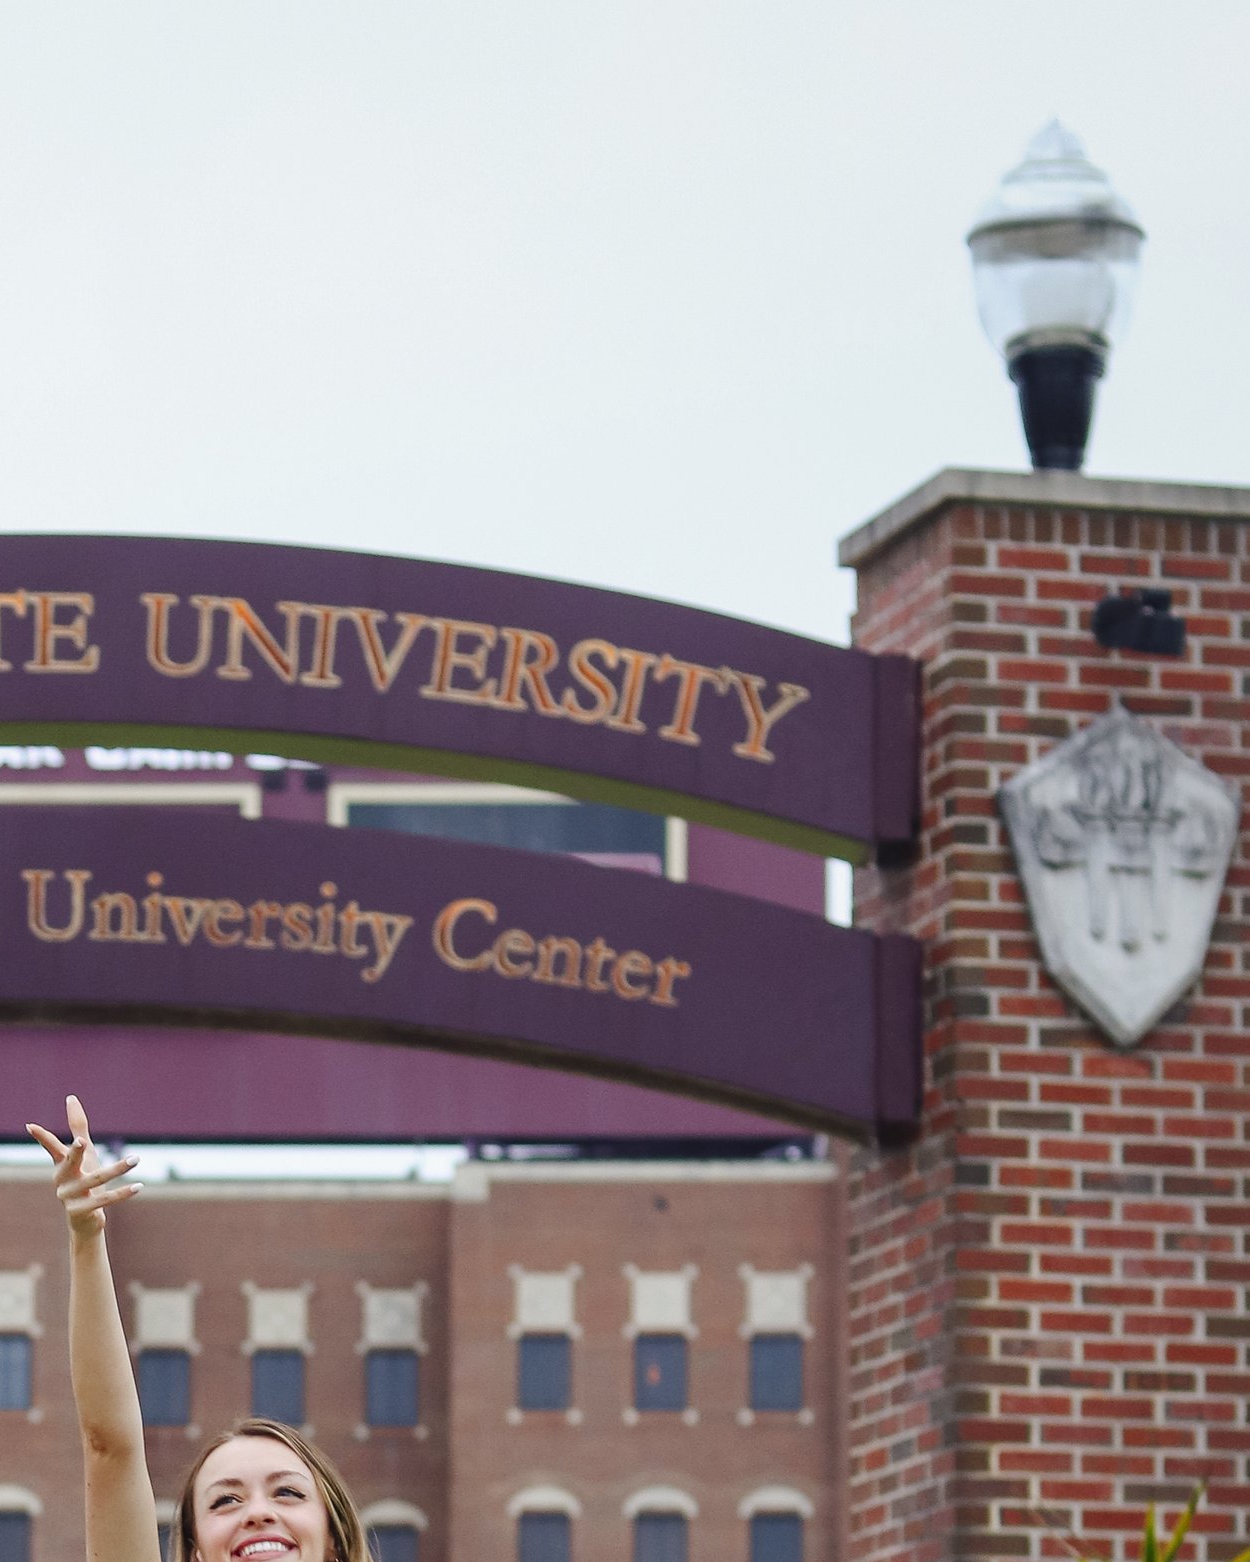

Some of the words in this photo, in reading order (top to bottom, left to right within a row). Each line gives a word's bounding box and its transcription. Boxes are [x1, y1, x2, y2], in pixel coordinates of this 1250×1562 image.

[141, 593, 809, 763] UNIVERSITY
[23, 869, 411, 982] University
[432, 899, 692, 1006] Center
